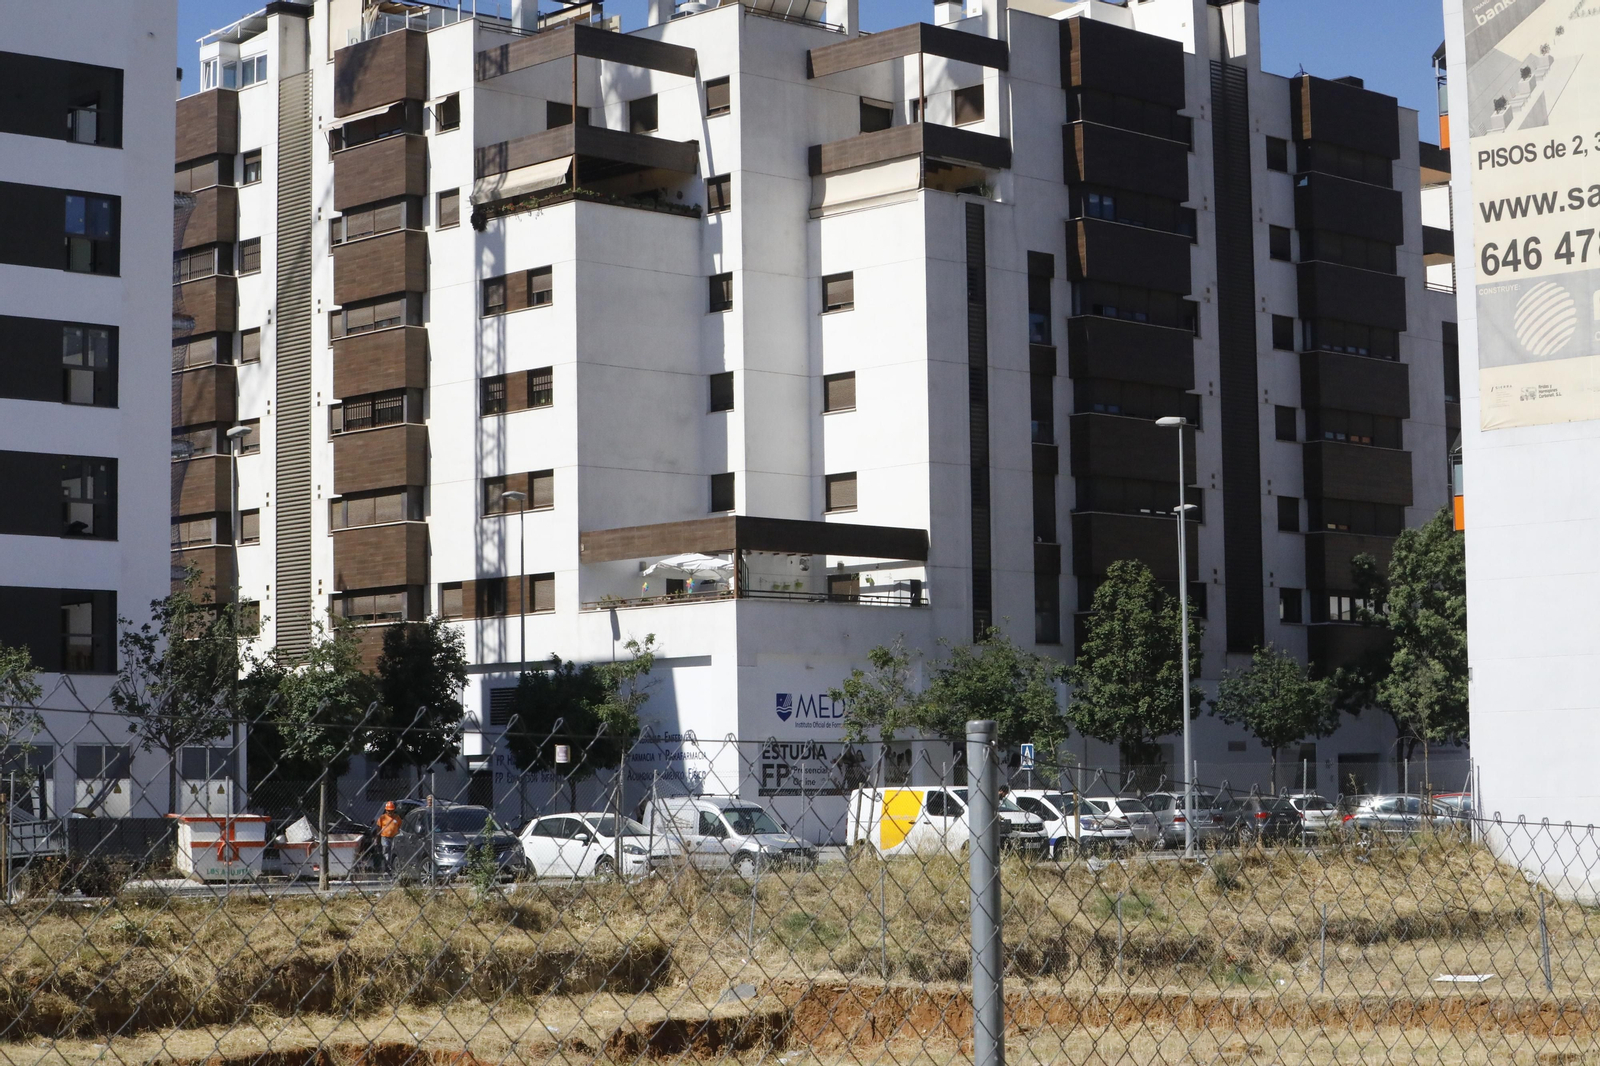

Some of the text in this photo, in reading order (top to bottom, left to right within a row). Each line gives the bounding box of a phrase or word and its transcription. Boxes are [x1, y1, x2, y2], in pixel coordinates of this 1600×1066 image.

[1475, 0, 1517, 26] bank
[1478, 143, 1537, 170] PISOS
[1543, 139, 1566, 160] de
[1572, 135, 1588, 157] 2,
[1481, 228, 1600, 276] 646 47
[1478, 283, 1521, 296] CONSTRUYE:
[762, 744, 828, 760] ESTUDIA
[762, 763, 828, 788] FP Prsencial
